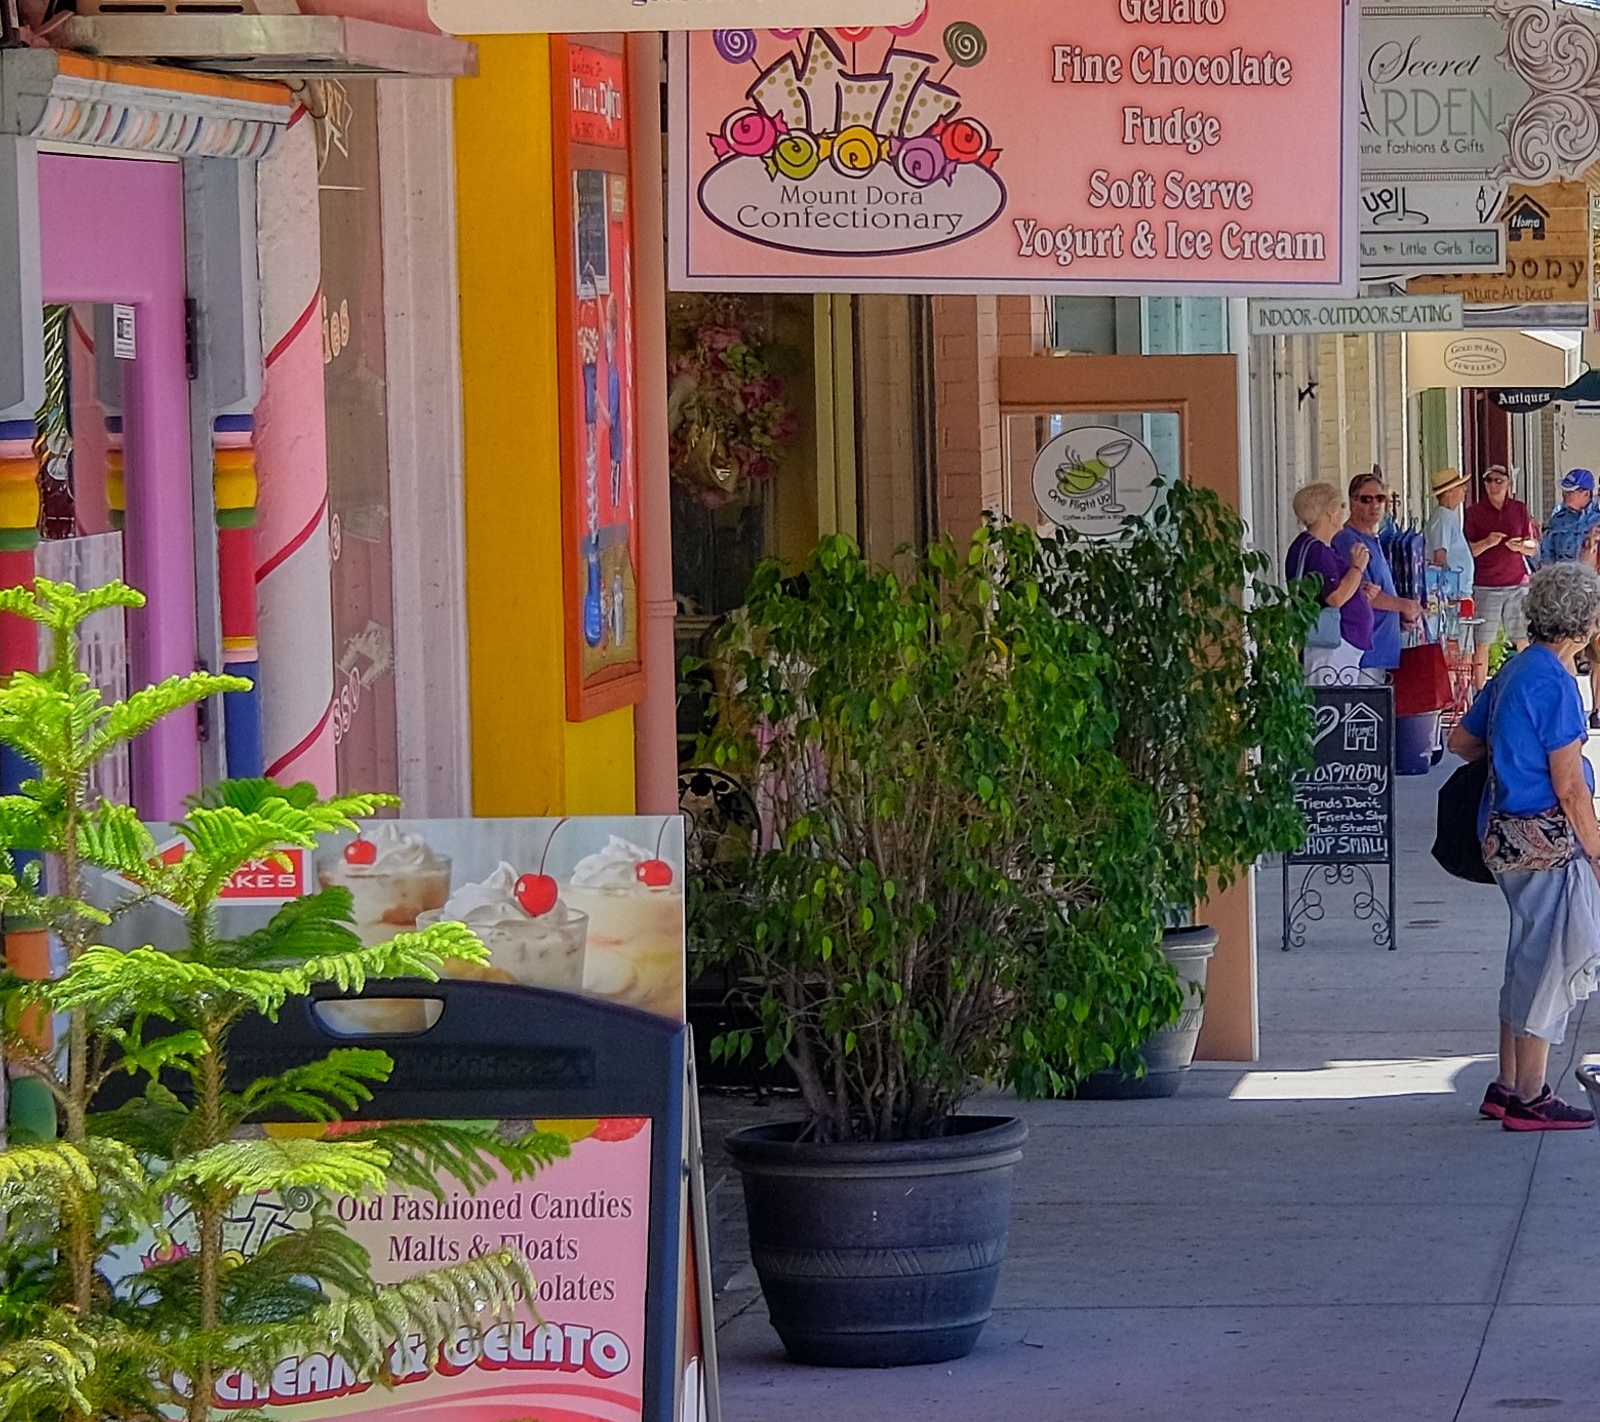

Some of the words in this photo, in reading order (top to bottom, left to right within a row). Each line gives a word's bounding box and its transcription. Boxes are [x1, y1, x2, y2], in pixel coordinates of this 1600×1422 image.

[1052, 45, 1121, 85] Fine
[1130, 45, 1292, 86] Chocolate
[1368, 36, 1481, 84] Secret
[1122, 106, 1222, 154] Fudge
[1387, 140, 1436, 155] Fashions
[1440, 140, 1450, 154] &
[1454, 138, 1485, 154] Gifts
[780, 184, 858, 206] Mount
[865, 186, 924, 206] Dora
[1088, 170, 1155, 210] Soft
[1164, 172, 1253, 210] Serve
[737, 205, 963, 236] Confectionary
[1512, 214, 1541, 228] Home
[1014, 219, 1123, 266] Yogurt
[1131, 223, 1157, 259] &
[1164, 222, 1212, 259] Ice
[1220, 222, 1326, 261] Cream
[1400, 241, 1427, 256] Little
[1434, 241, 1462, 255] Girls
[1470, 239, 1493, 254] Too
[1443, 284, 1502, 301] Fniture
[1391, 304, 1452, 324] SEATING
[1498, 391, 1550, 406] Antiques
[392, 1192, 522, 1221] Fashioned
[531, 1190, 632, 1219] Candies
[388, 1234, 460, 1262] Malts
[467, 1235, 488, 1261] &
[440, 1322, 630, 1375] GELATO
